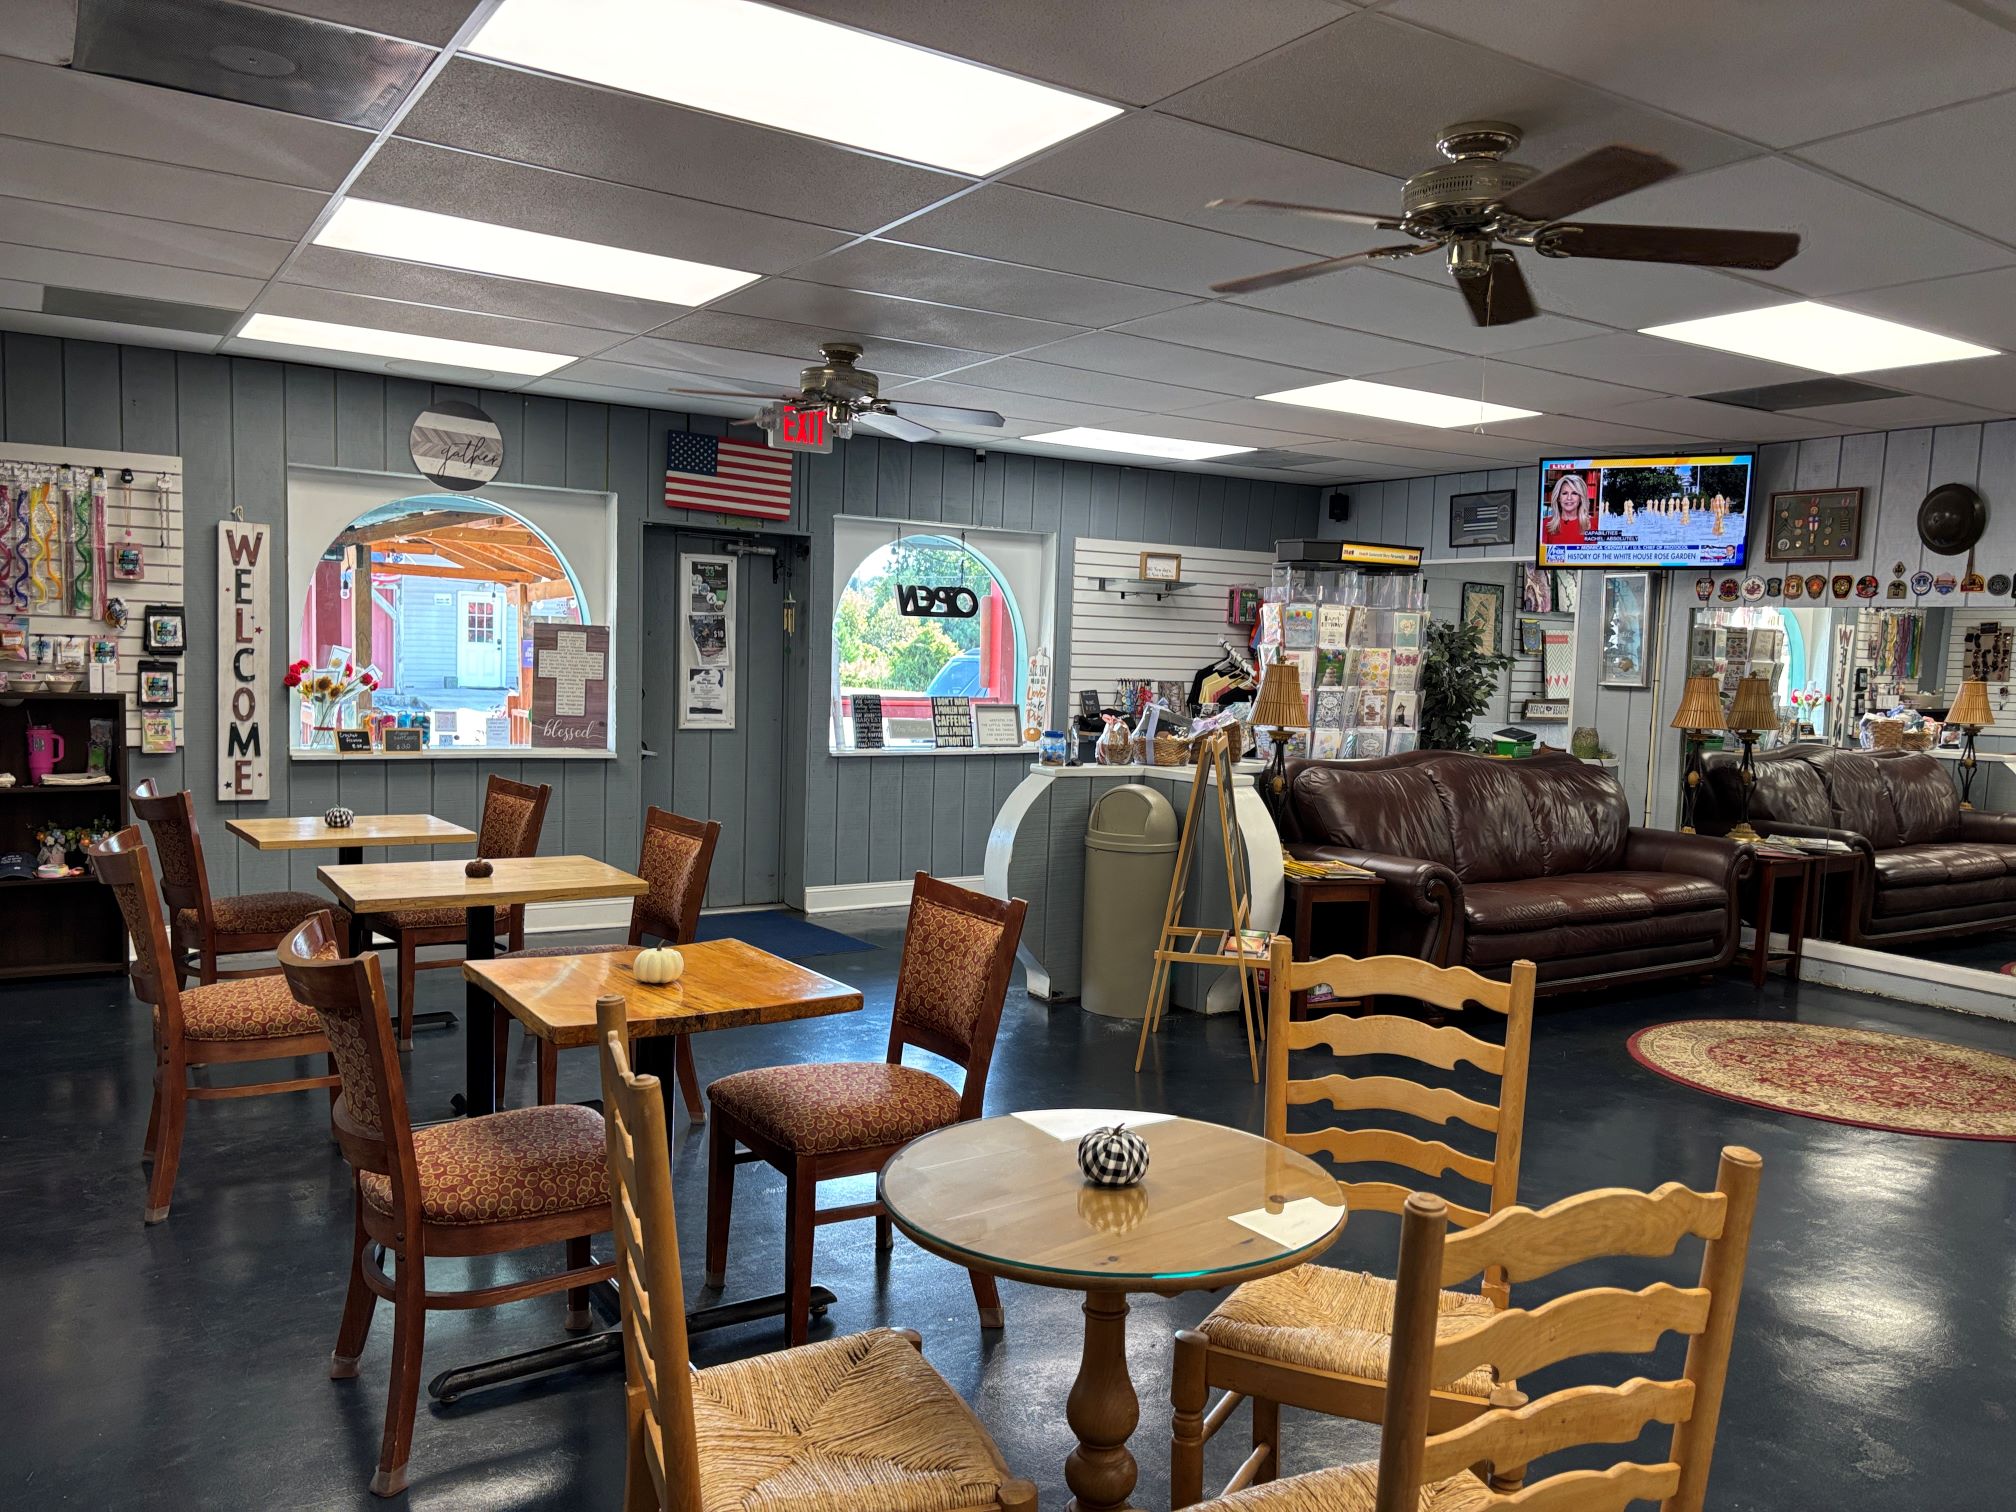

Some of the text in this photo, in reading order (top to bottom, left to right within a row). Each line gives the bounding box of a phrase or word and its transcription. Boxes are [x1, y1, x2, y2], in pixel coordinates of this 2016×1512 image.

[783, 405, 827, 447] EXIT
[437, 437, 498, 478] gather
[713, 630, 724, 638] $10
[225, 529, 263, 795] WELCOME
[1027, 686, 1046, 700] Love
[937, 697, 954, 706] DON'T
[954, 697, 969, 706] HAVE
[938, 706, 958, 715] PROBLEM
[958, 706, 970, 715] WITH
[1026, 709, 1043, 723] Pie
[935, 715, 971, 727] CAFFEINE
[542, 719, 599, 741] blessed
[937, 736, 963, 747] WITHOUT
